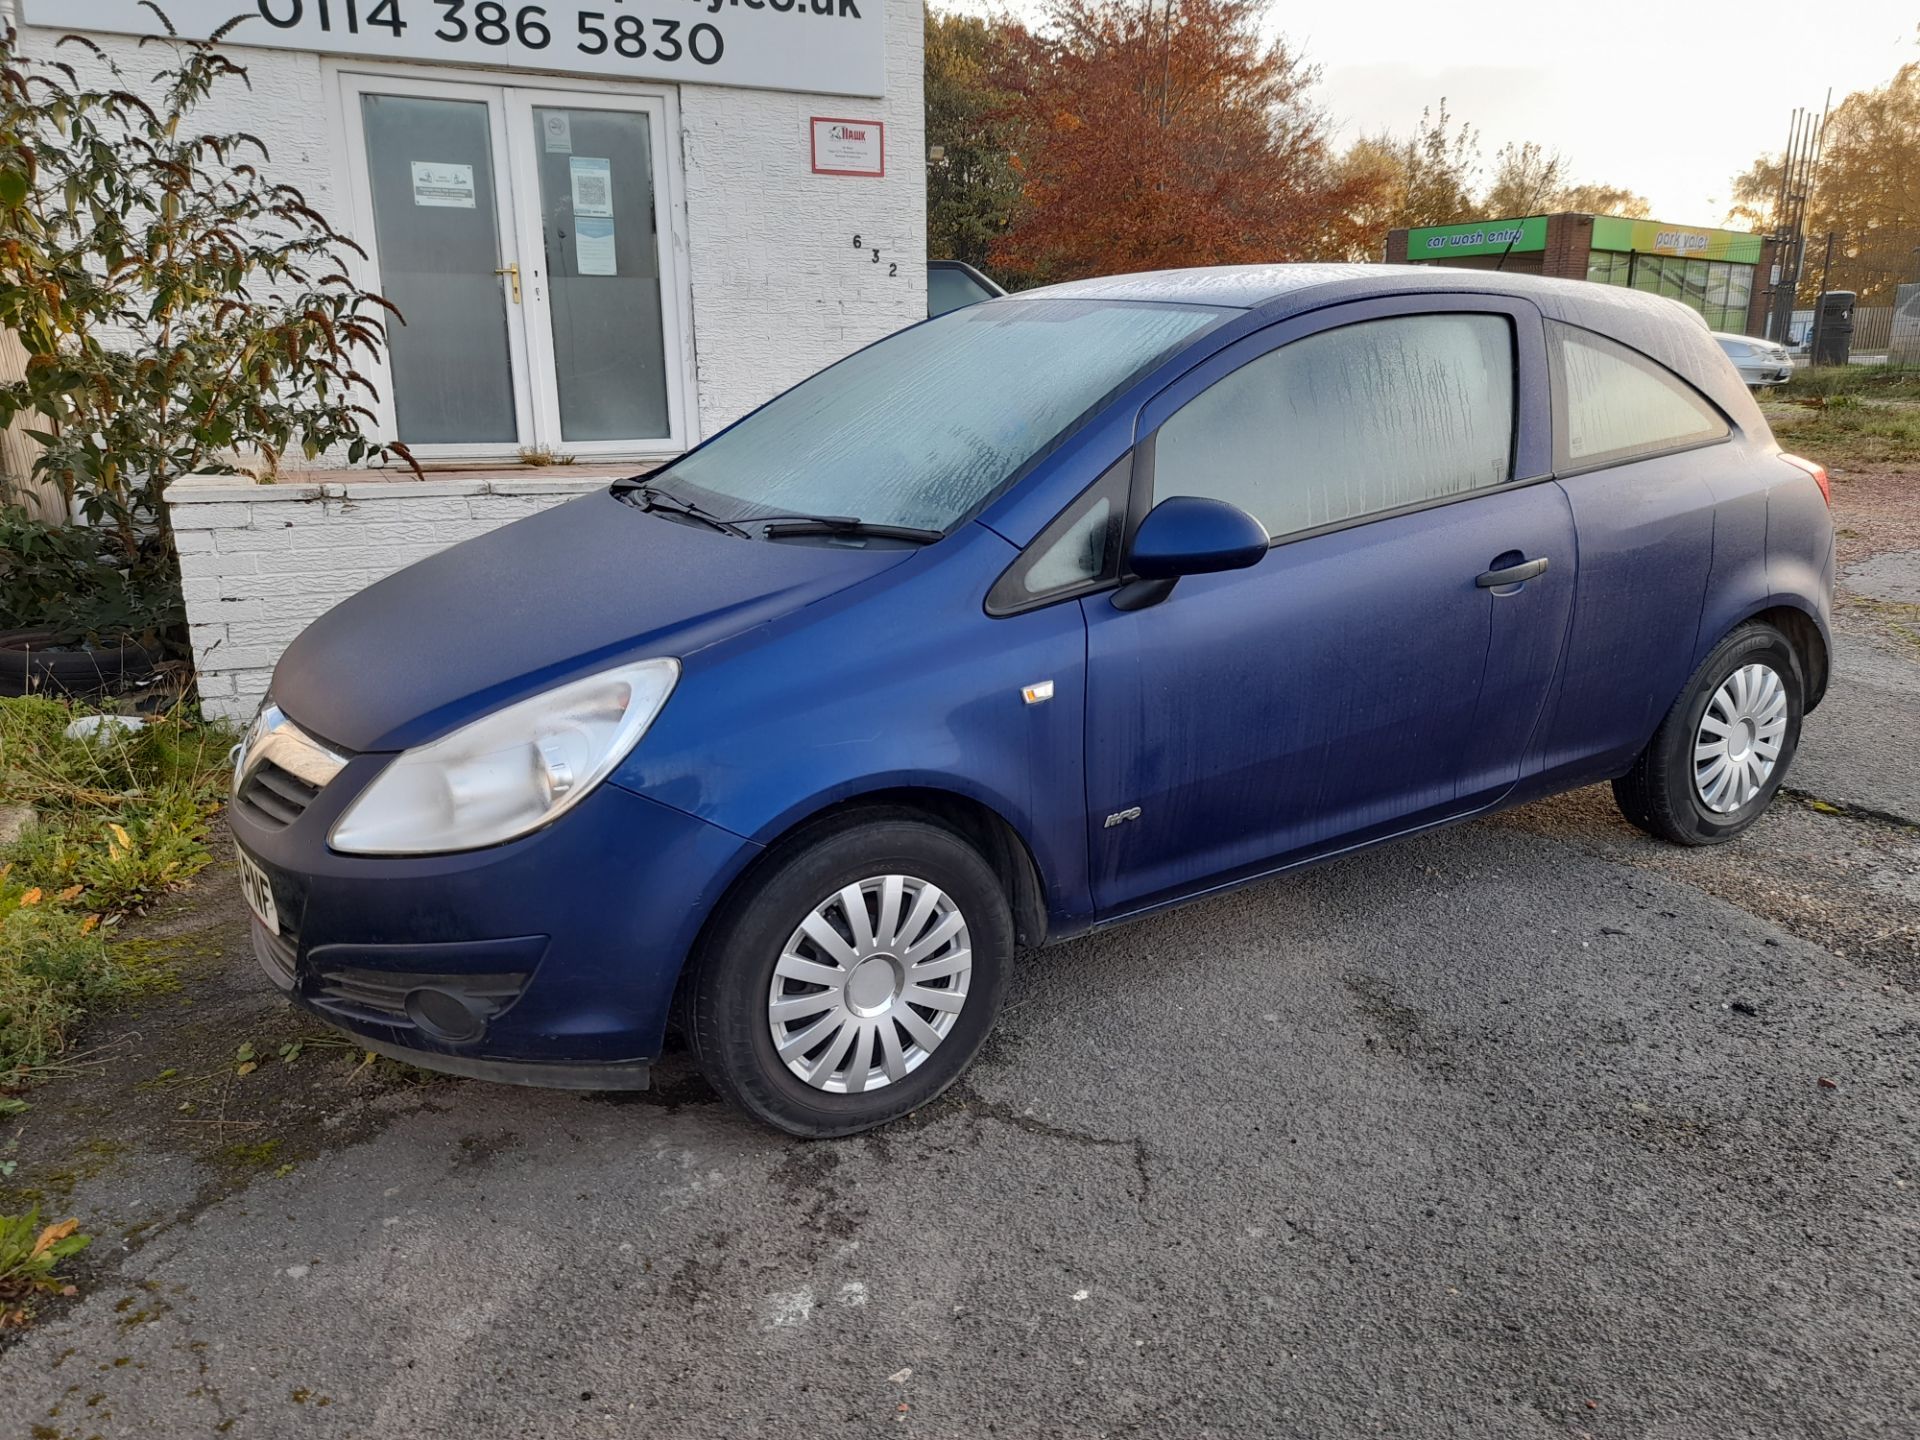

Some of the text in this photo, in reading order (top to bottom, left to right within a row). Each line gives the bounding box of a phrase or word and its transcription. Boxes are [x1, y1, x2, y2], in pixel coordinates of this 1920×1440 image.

[258, 0, 725, 65] 0114 386 5830
[1427, 229, 1523, 248] car wash entry
[1655, 231, 1681, 249] park
